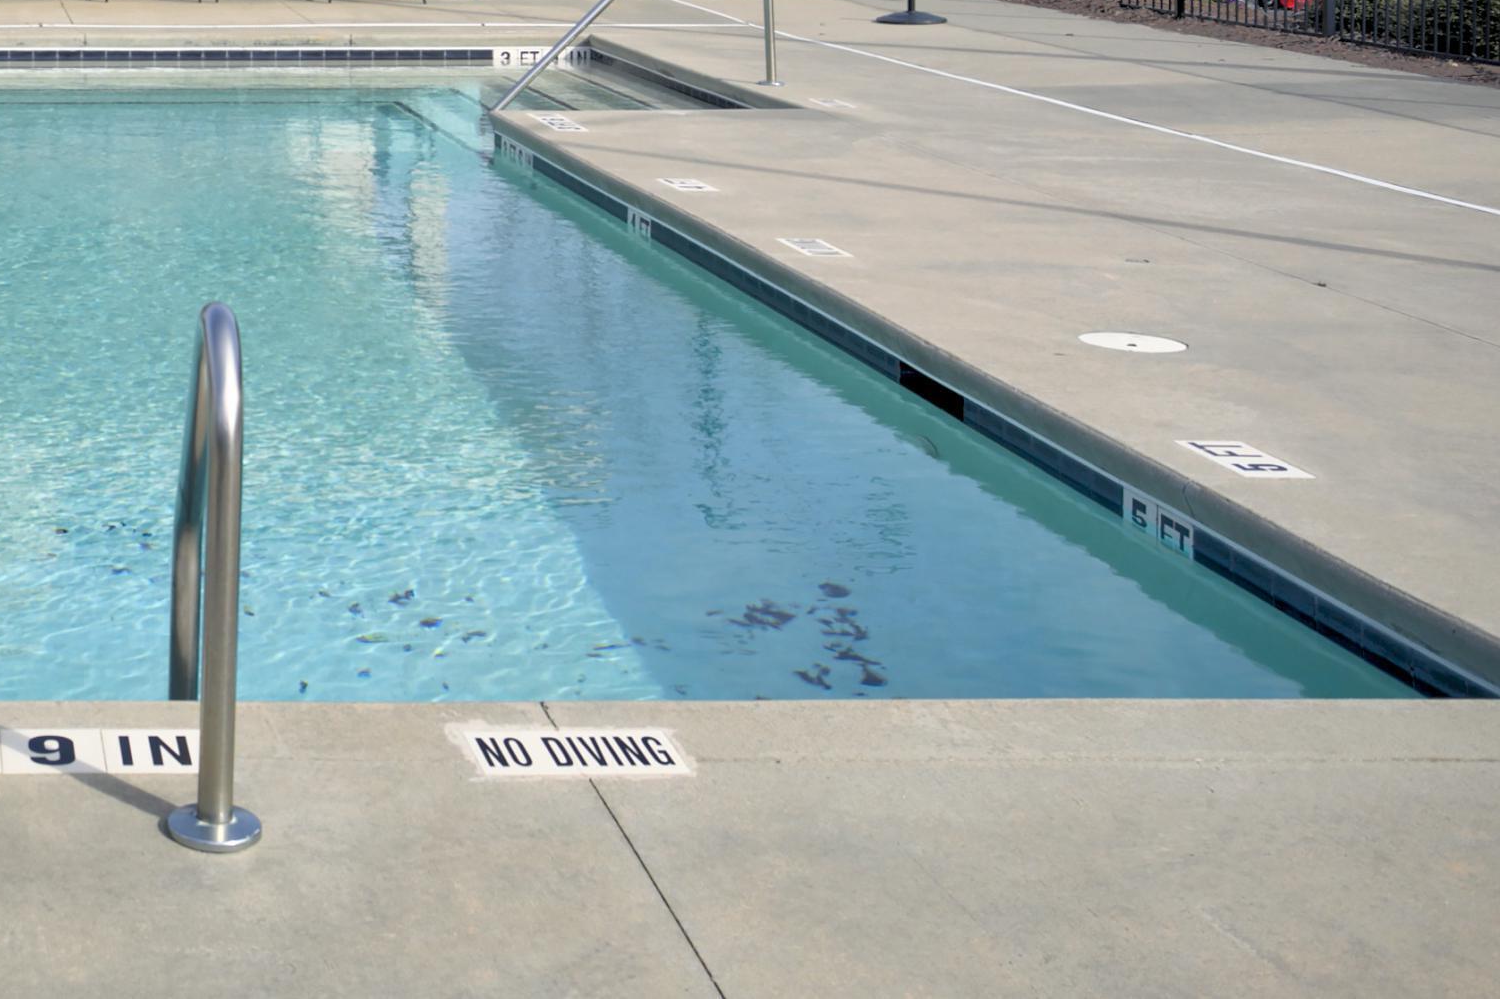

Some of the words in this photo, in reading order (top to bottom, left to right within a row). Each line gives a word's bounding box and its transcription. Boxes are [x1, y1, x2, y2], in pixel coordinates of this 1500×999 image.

[501, 51, 511, 66] 3
[1188, 442, 1263, 457] FT
[1231, 463, 1288, 471] 5
[1132, 497, 1147, 528] 5
[1161, 513, 1190, 552] FT
[28, 735, 75, 766] 9
[118, 735, 193, 766] IN
[475, 737, 533, 767] NO
[540, 736, 676, 766] DIVING
